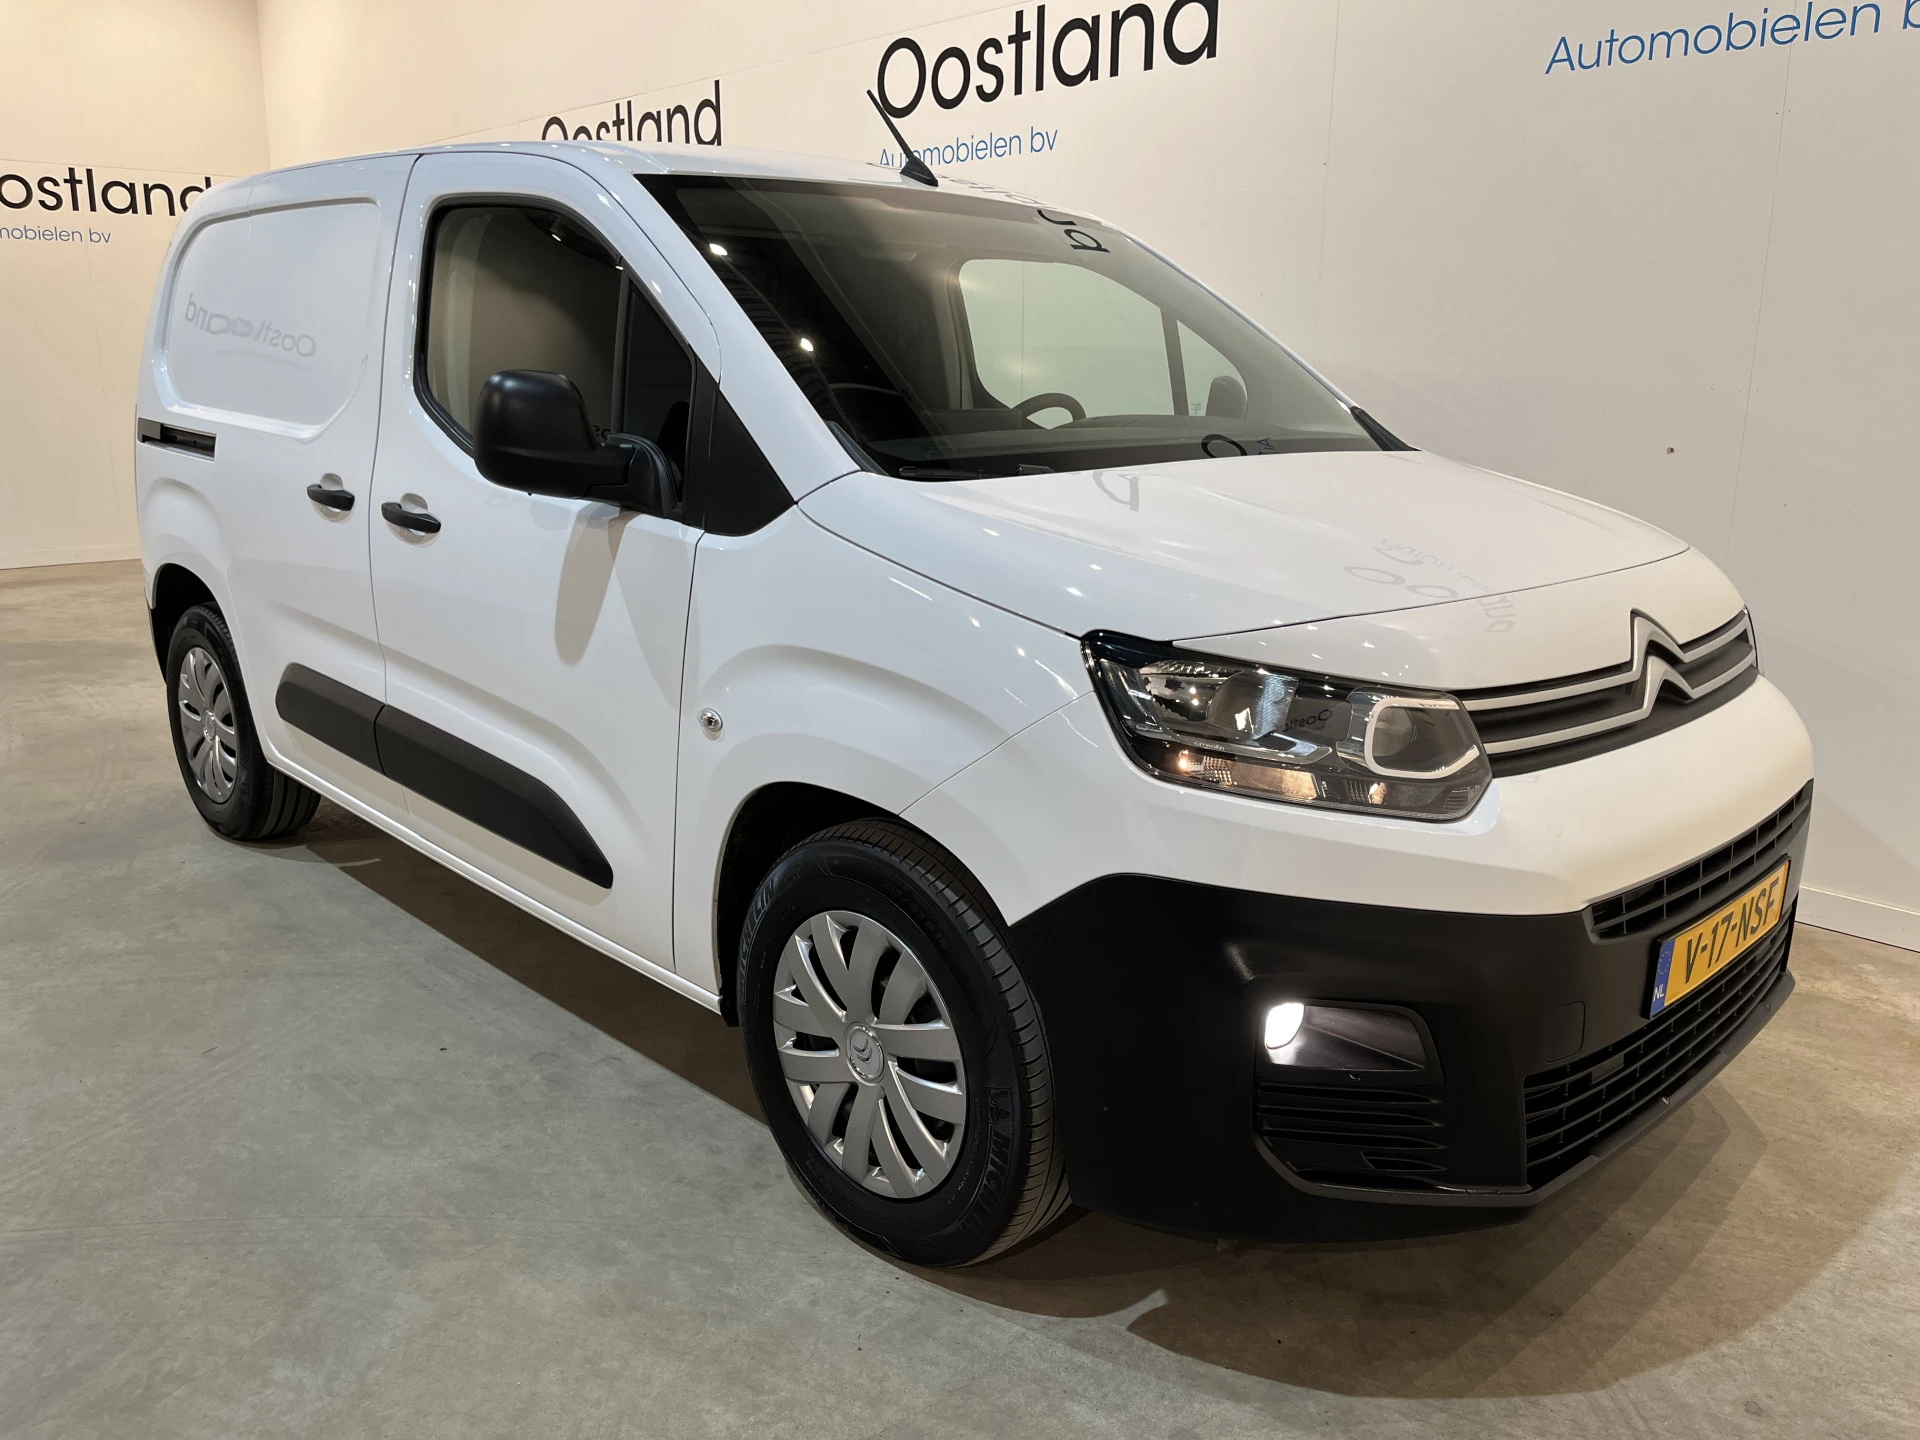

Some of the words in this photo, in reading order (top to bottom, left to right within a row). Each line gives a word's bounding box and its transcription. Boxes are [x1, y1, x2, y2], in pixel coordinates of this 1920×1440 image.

[877, 0, 1218, 119] Oostland
[1545, 1, 1881, 75] Automobielen
[880, 132, 1022, 169] Auomobielen
[1030, 126, 1058, 153] bv
[89, 228, 112, 244] bv
[1685, 876, 1780, 985] V-17-NSF
[1653, 983, 1665, 1002] NL
